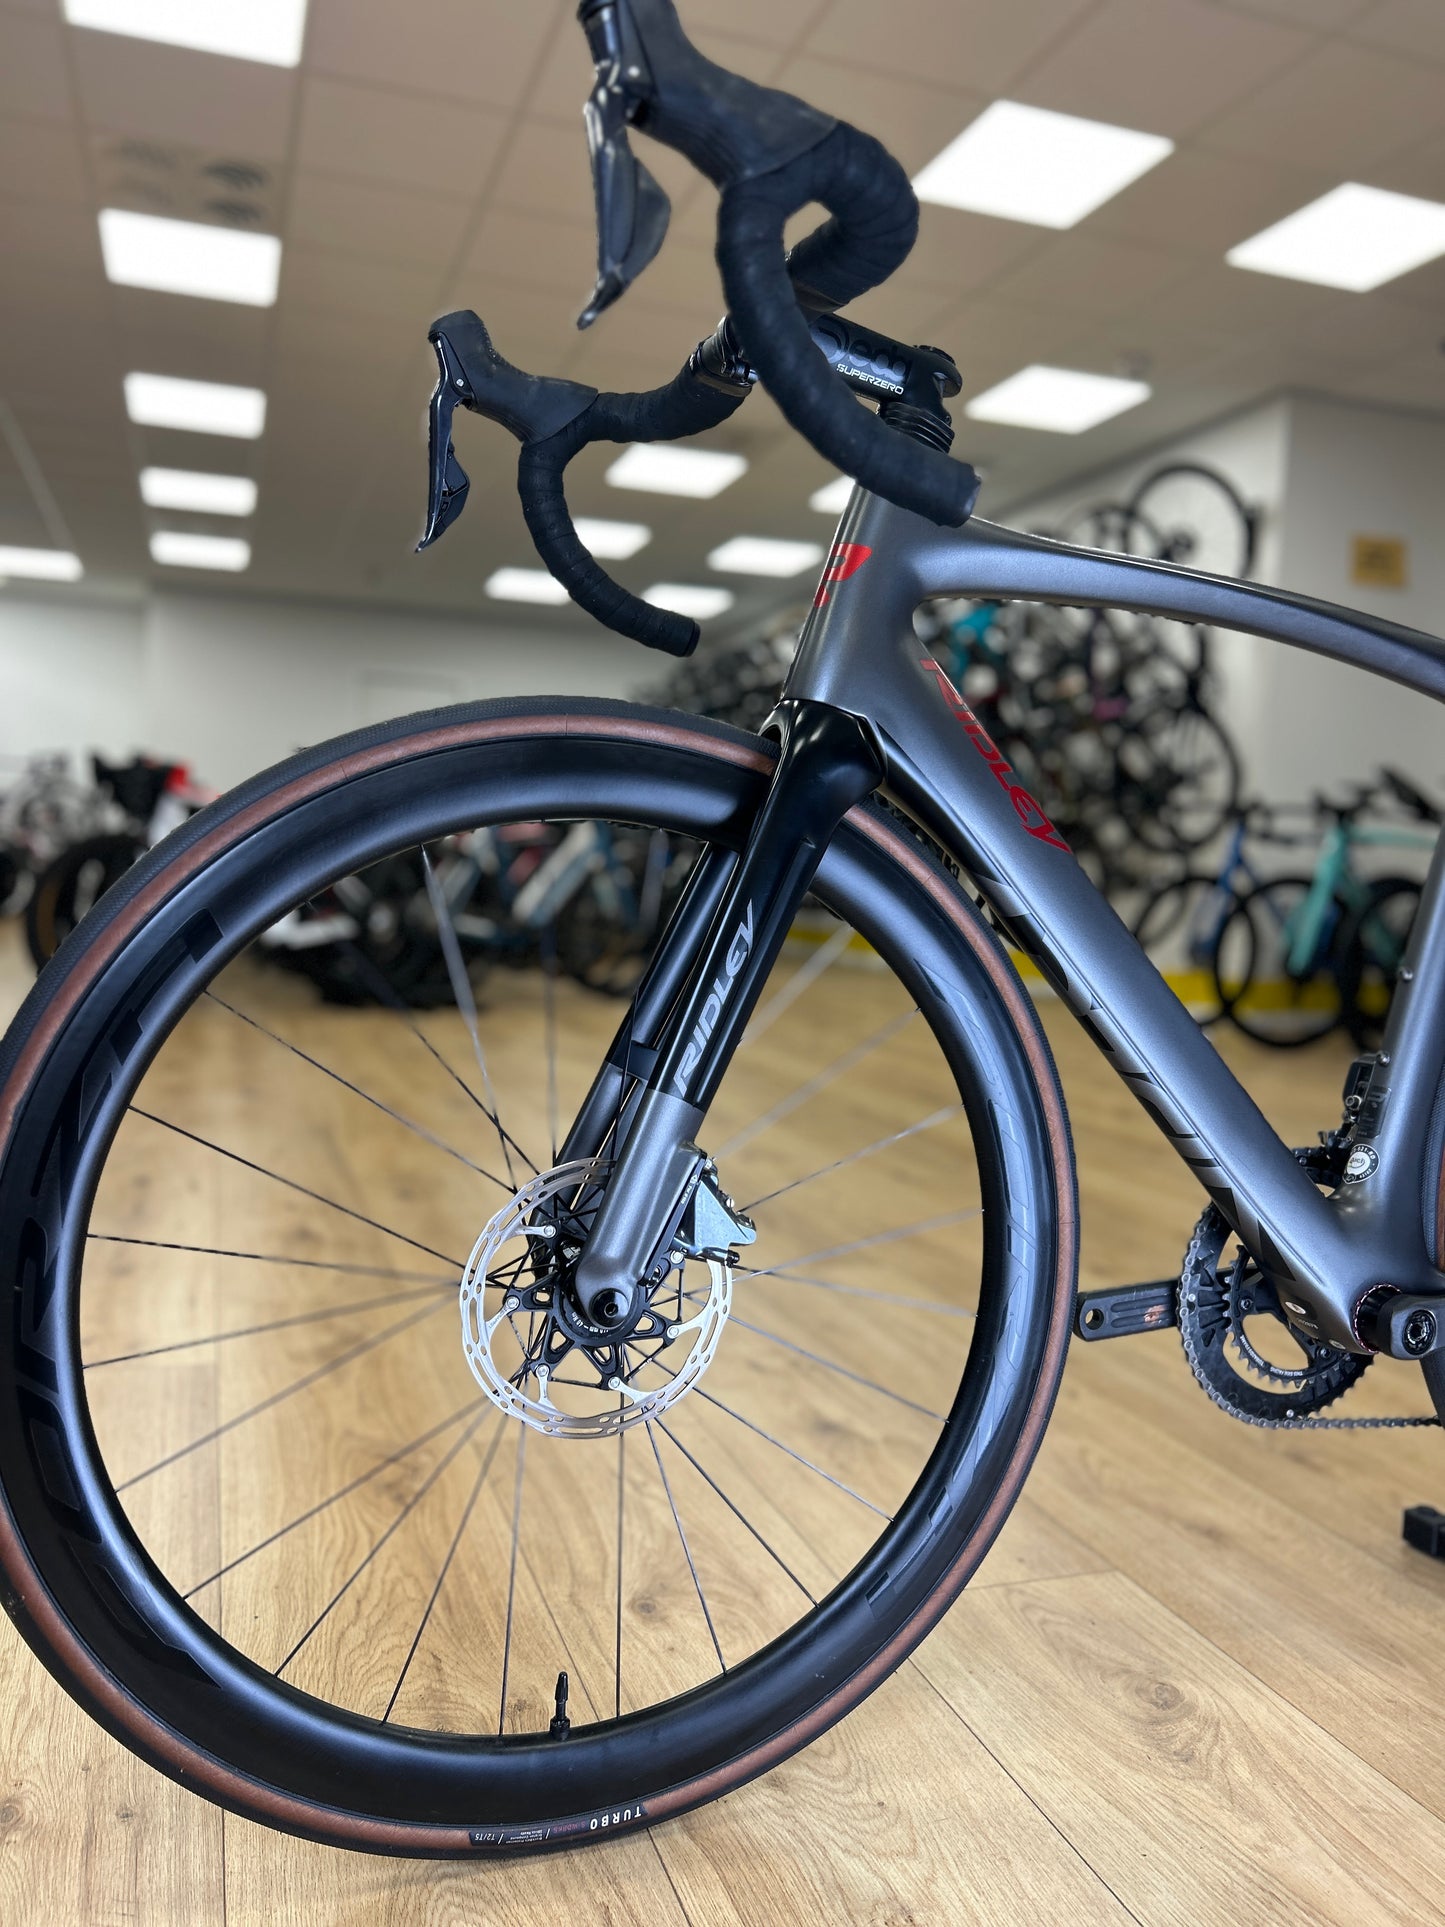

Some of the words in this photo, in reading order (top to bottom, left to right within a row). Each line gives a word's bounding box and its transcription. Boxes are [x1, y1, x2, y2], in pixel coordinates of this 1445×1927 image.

[837, 363, 904, 395] SUPERZERO
[920, 658, 1073, 855] RIDLEY
[673, 898, 754, 1098] RIDLEY
[590, 1806, 642, 1830] TURBO
[474, 1833, 496, 1841] T2/T5
